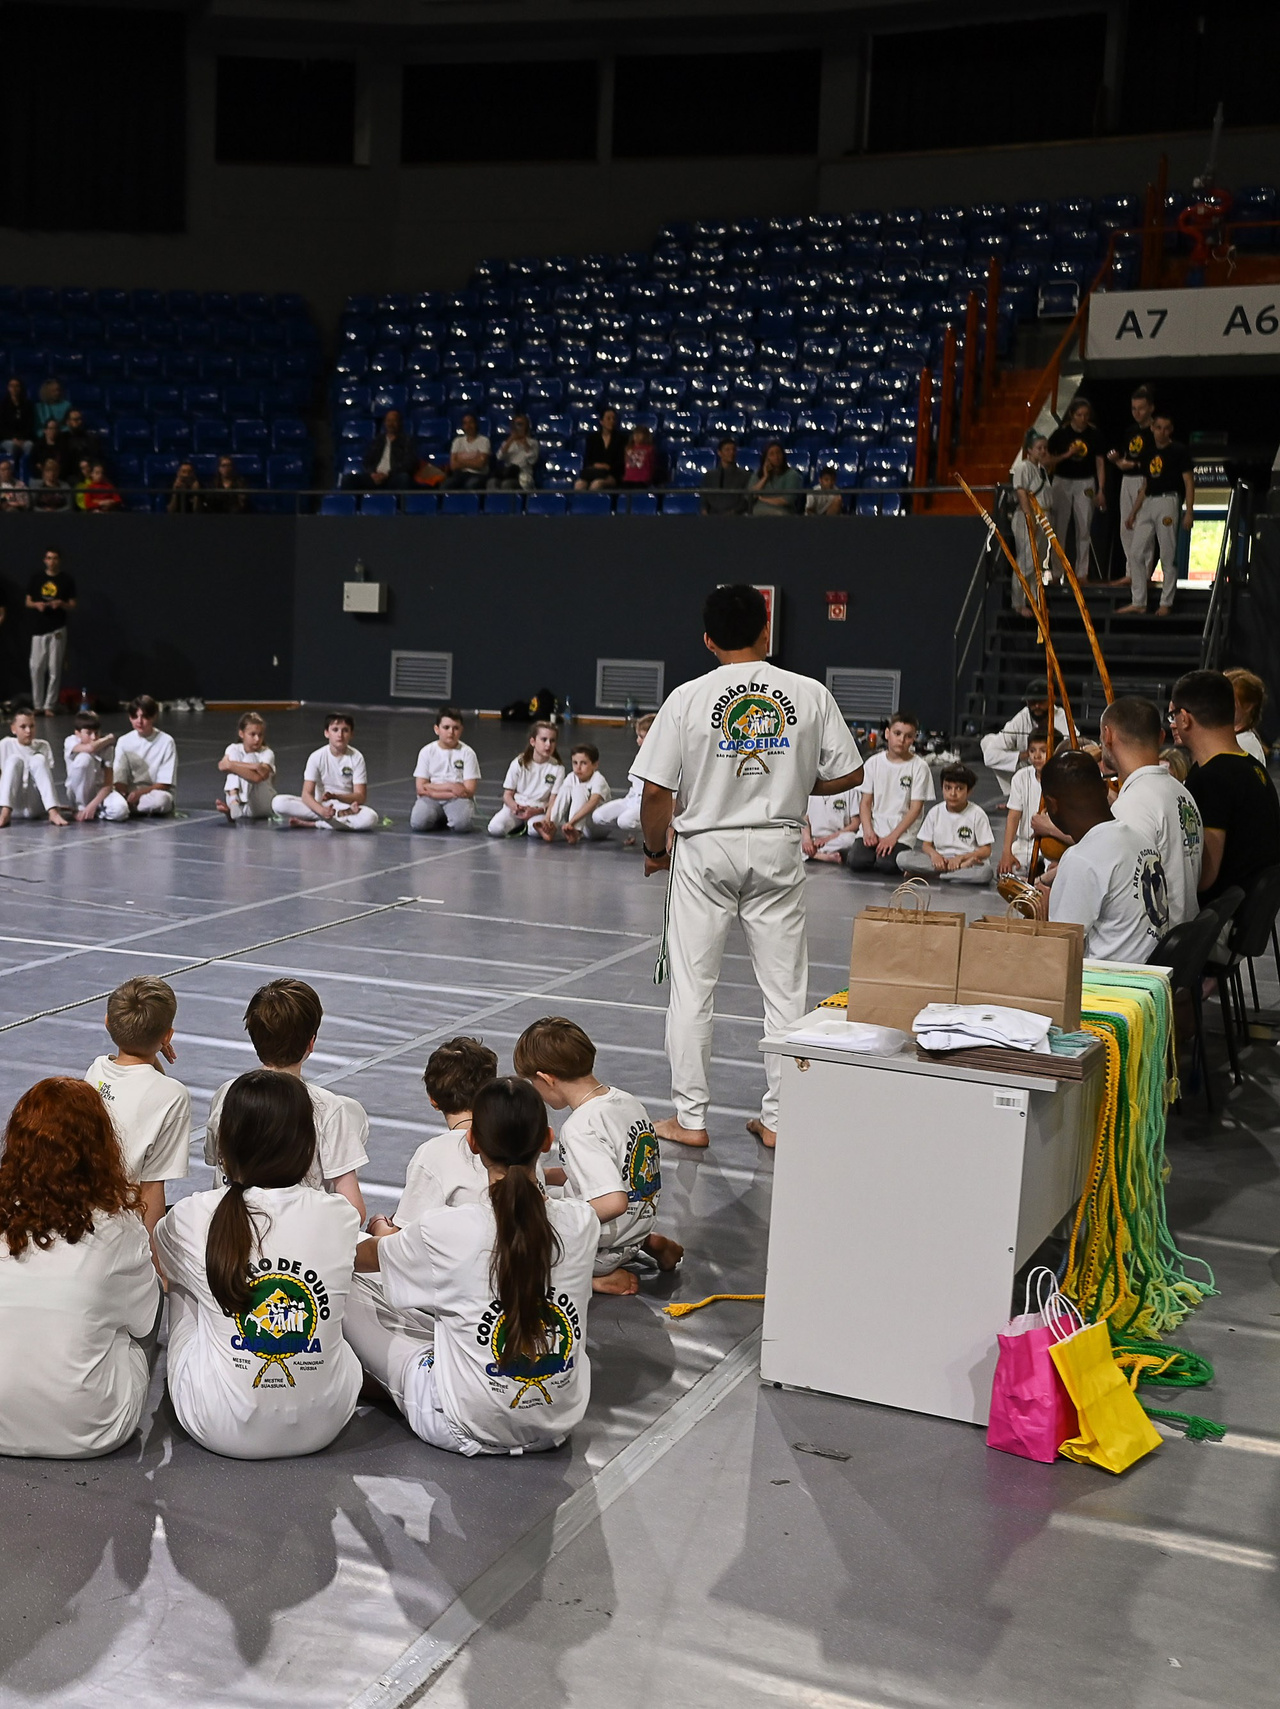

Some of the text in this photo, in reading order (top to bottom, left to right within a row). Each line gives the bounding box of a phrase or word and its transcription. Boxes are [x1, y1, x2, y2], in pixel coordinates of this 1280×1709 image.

[1115, 304, 1279, 340] A7 A6
[711, 682, 798, 729] CORDÃO DE OURO
[718, 737, 790, 751] CAPOEIRA
[277, 1258, 302, 1275] DE
[304, 1269, 331, 1320] OURO
[476, 1299, 503, 1346] CORD
[557, 1293, 581, 1340] OURO
[231, 1335, 322, 1353] CAPOEIRA
[232, 1357, 251, 1365] MESTRE
